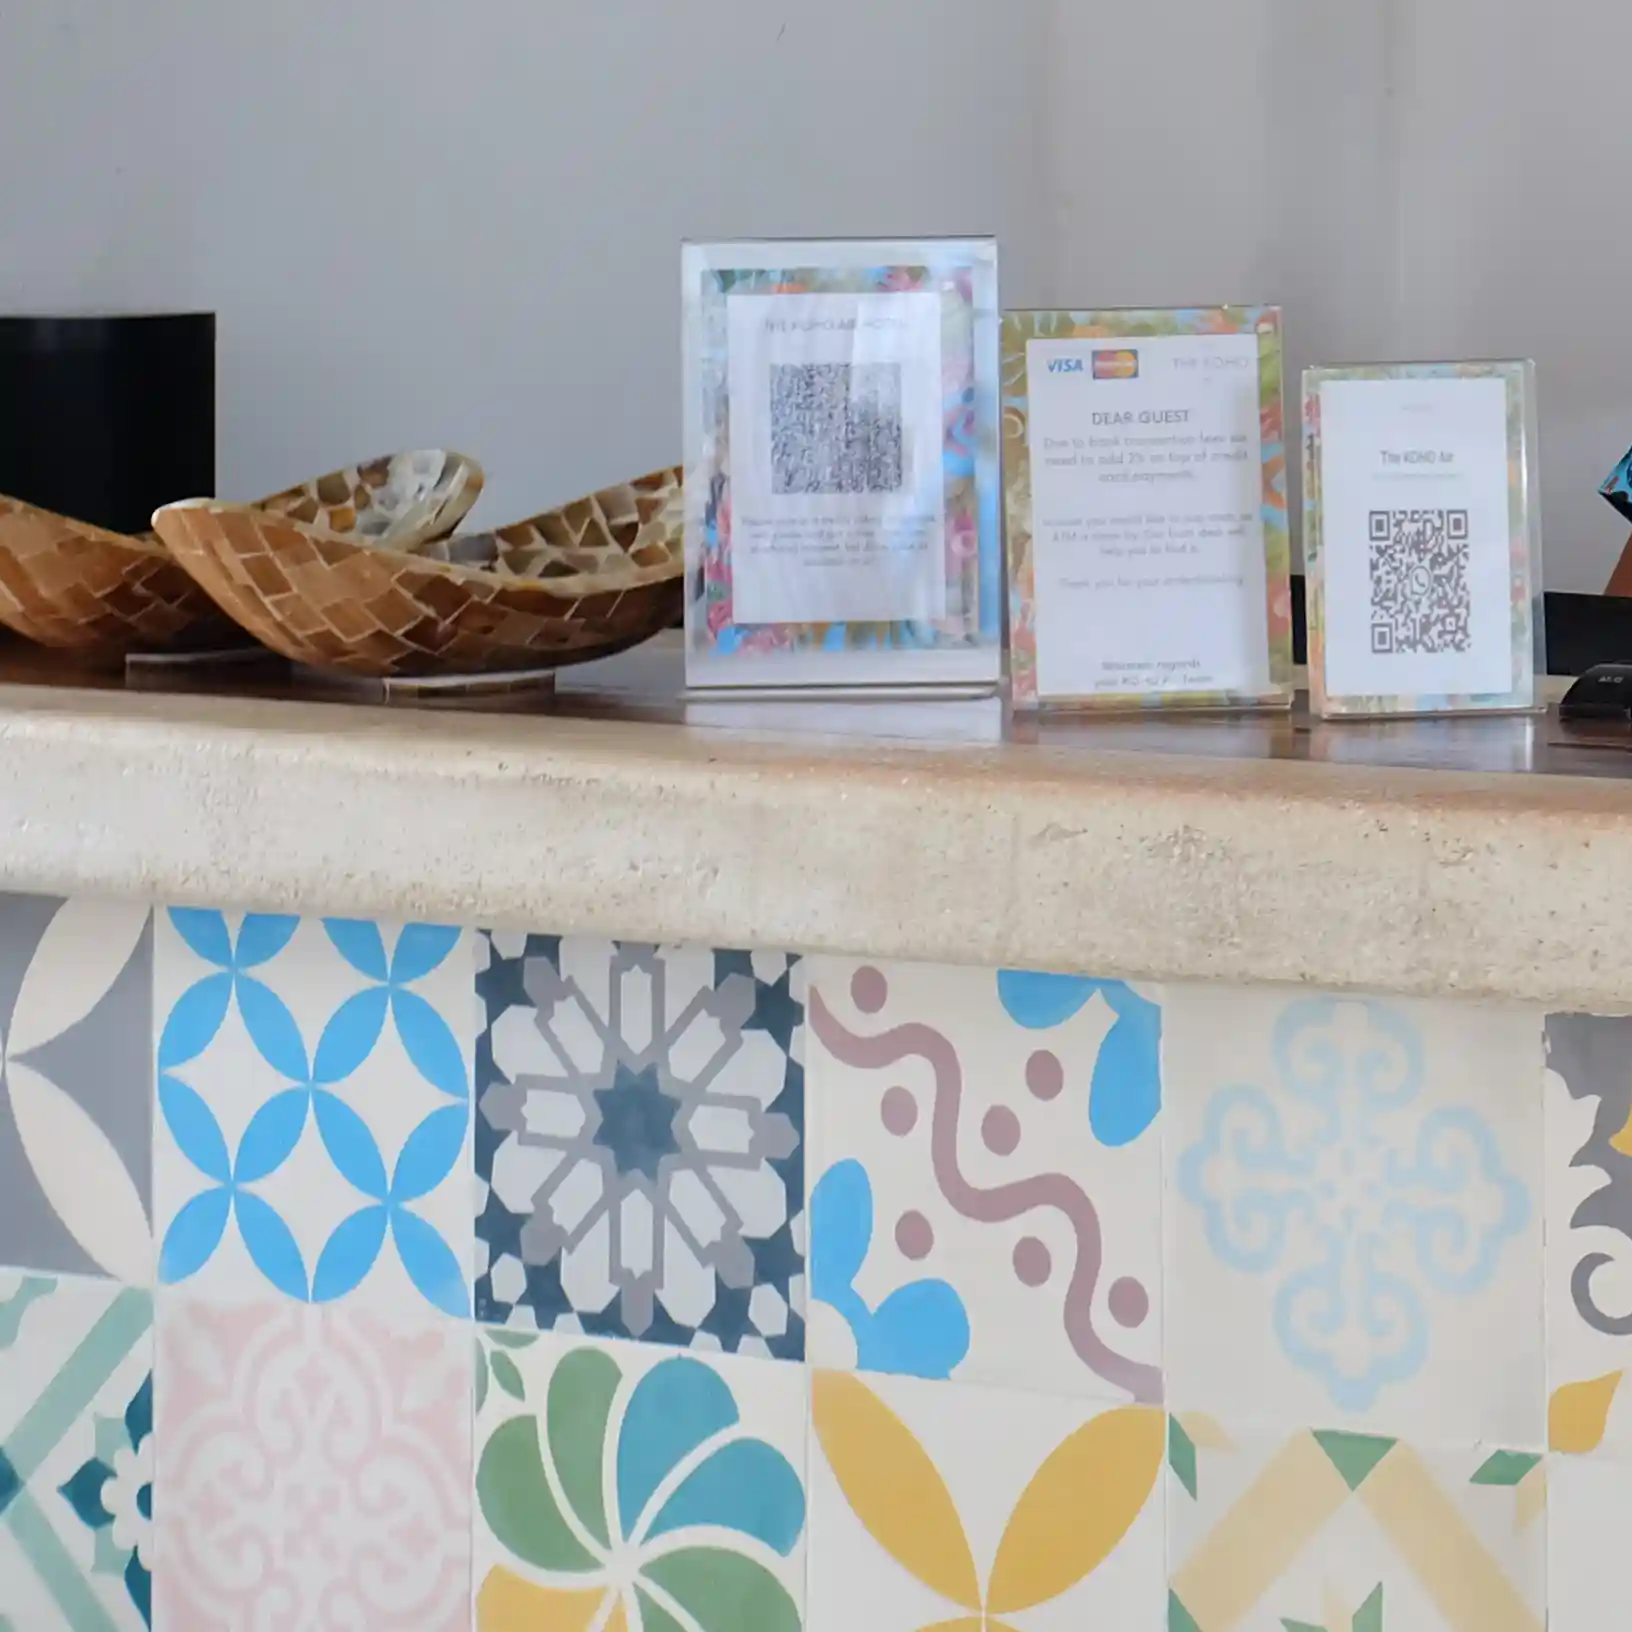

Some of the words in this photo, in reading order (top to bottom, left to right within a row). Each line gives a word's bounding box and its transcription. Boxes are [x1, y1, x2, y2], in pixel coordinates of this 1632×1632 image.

[1046, 358, 1084, 373] VISA
[1092, 411, 1133, 427] DEAR
[1138, 409, 1190, 424] GUEST
